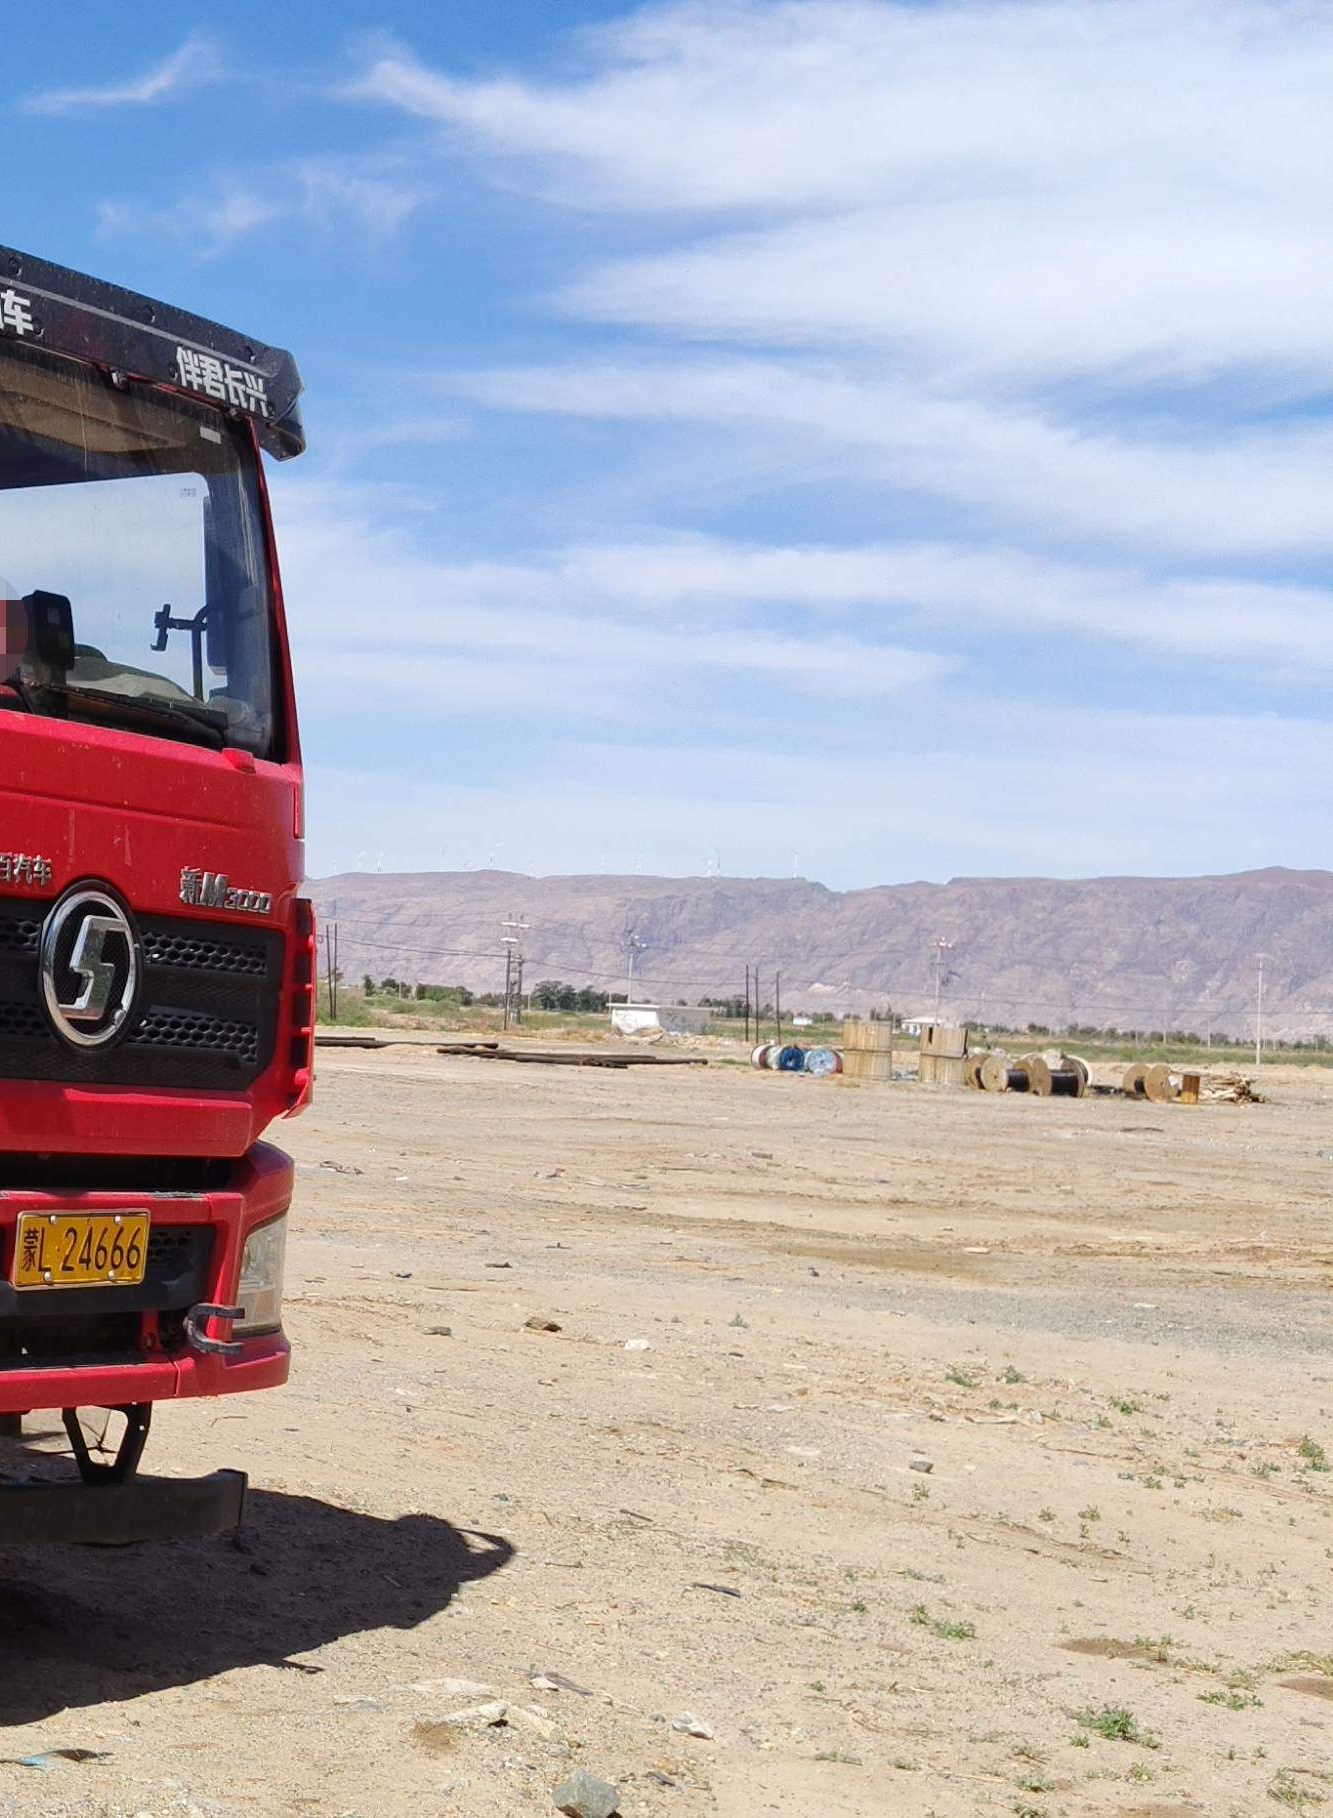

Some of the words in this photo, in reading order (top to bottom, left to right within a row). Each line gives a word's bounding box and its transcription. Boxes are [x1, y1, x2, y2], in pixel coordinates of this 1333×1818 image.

[176, 346, 268, 418] 伴君长兴
[179, 866, 273, 914] 新M3000
